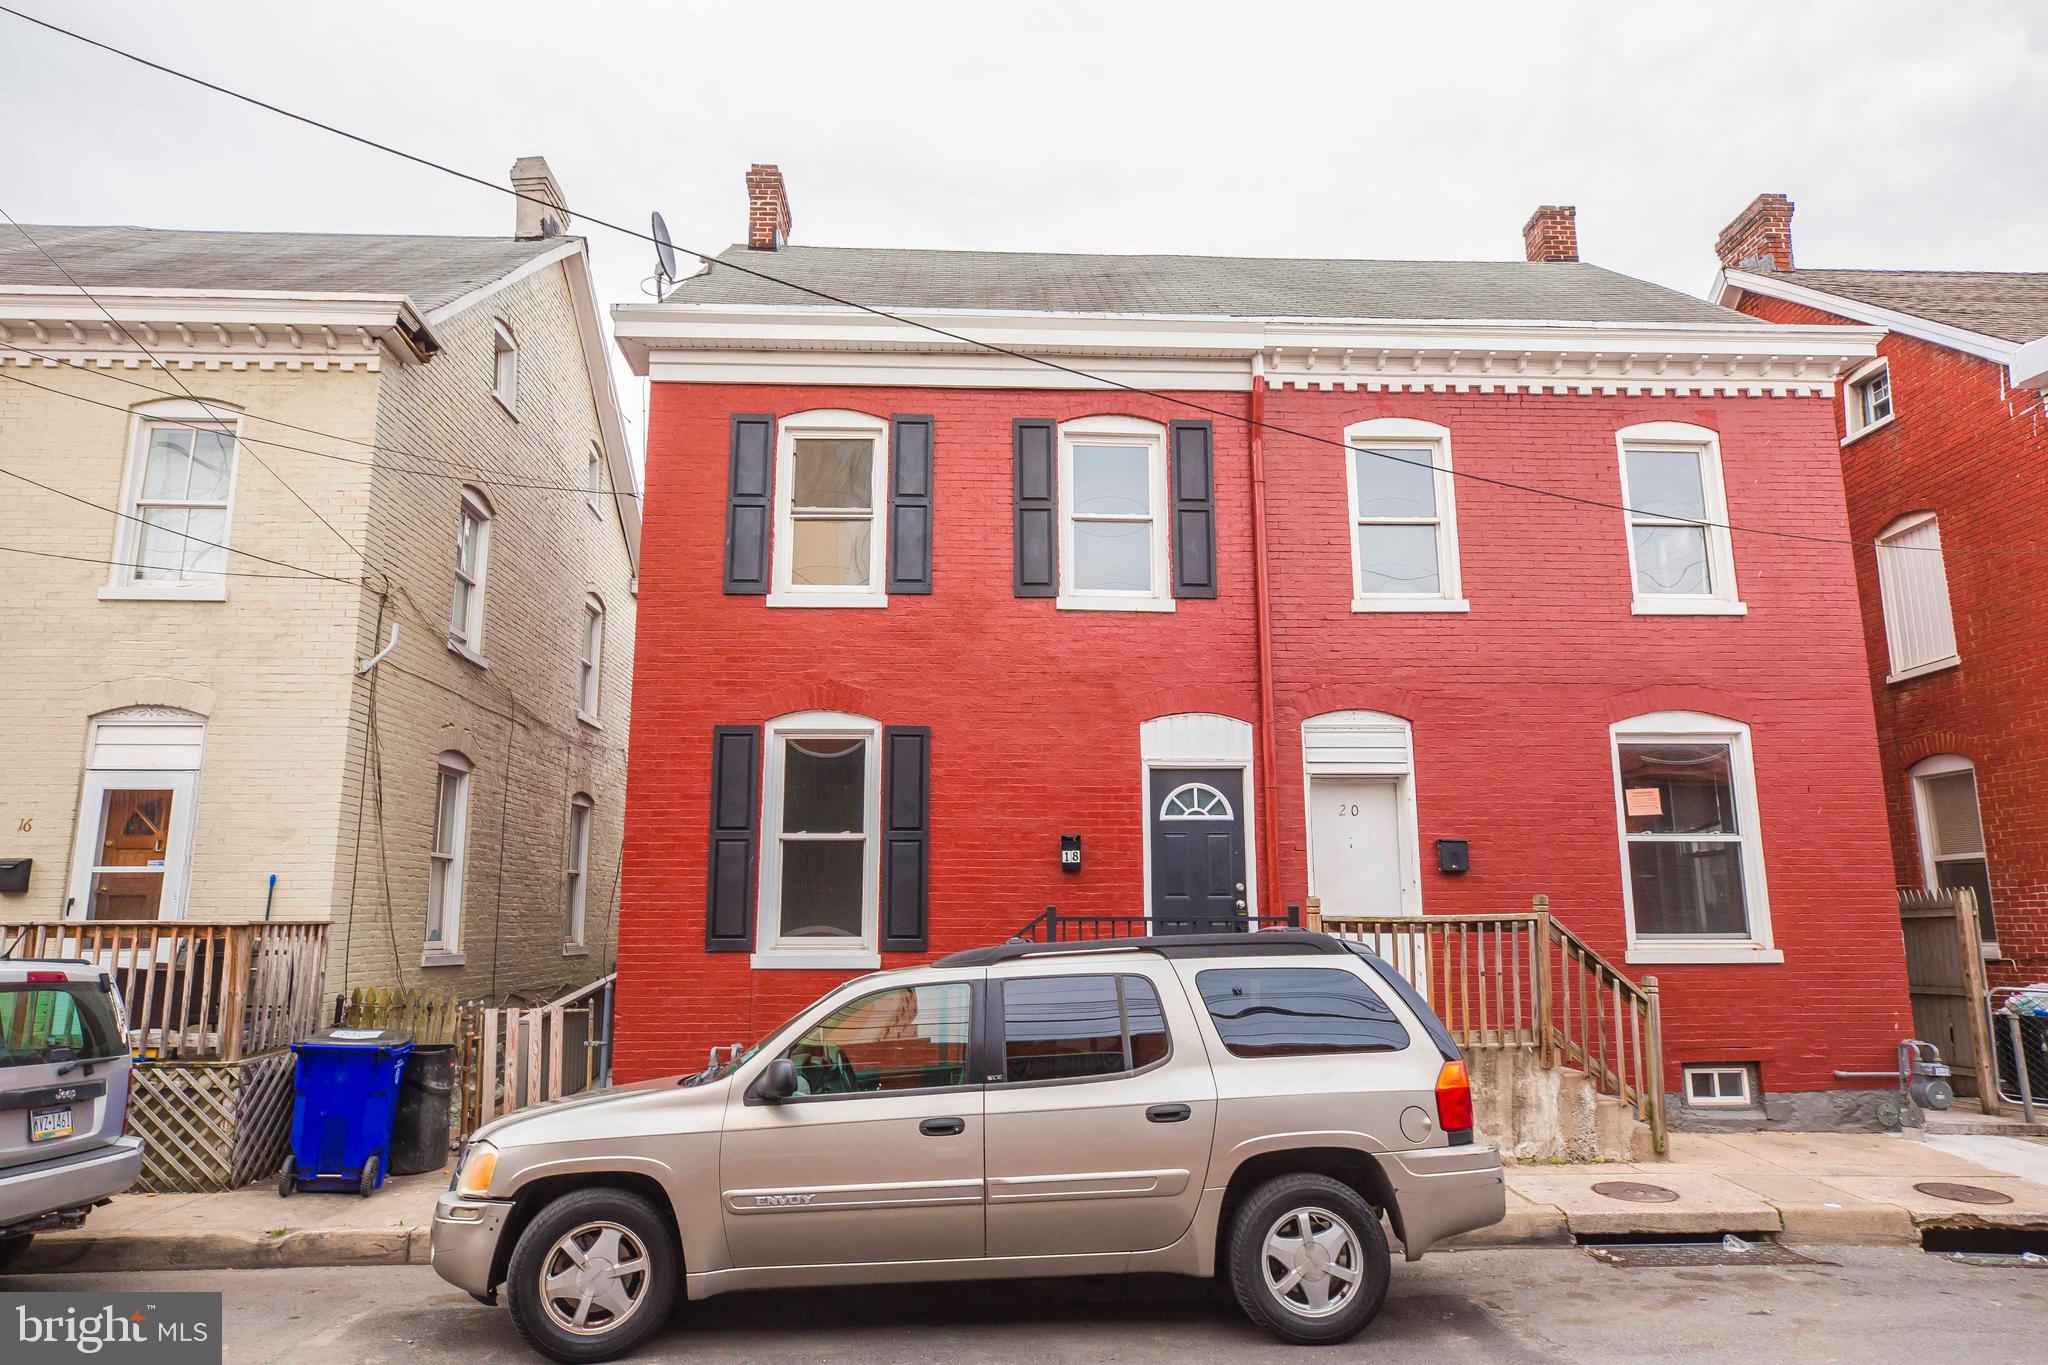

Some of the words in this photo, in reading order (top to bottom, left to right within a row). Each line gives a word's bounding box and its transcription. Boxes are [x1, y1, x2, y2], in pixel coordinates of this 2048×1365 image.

[1338, 804, 1359, 816] 20
[17, 818, 32, 832] 16
[1065, 851, 1079, 861] 18
[55, 1088, 76, 1100] Jeep
[755, 1193, 816, 1206] ENVOY
